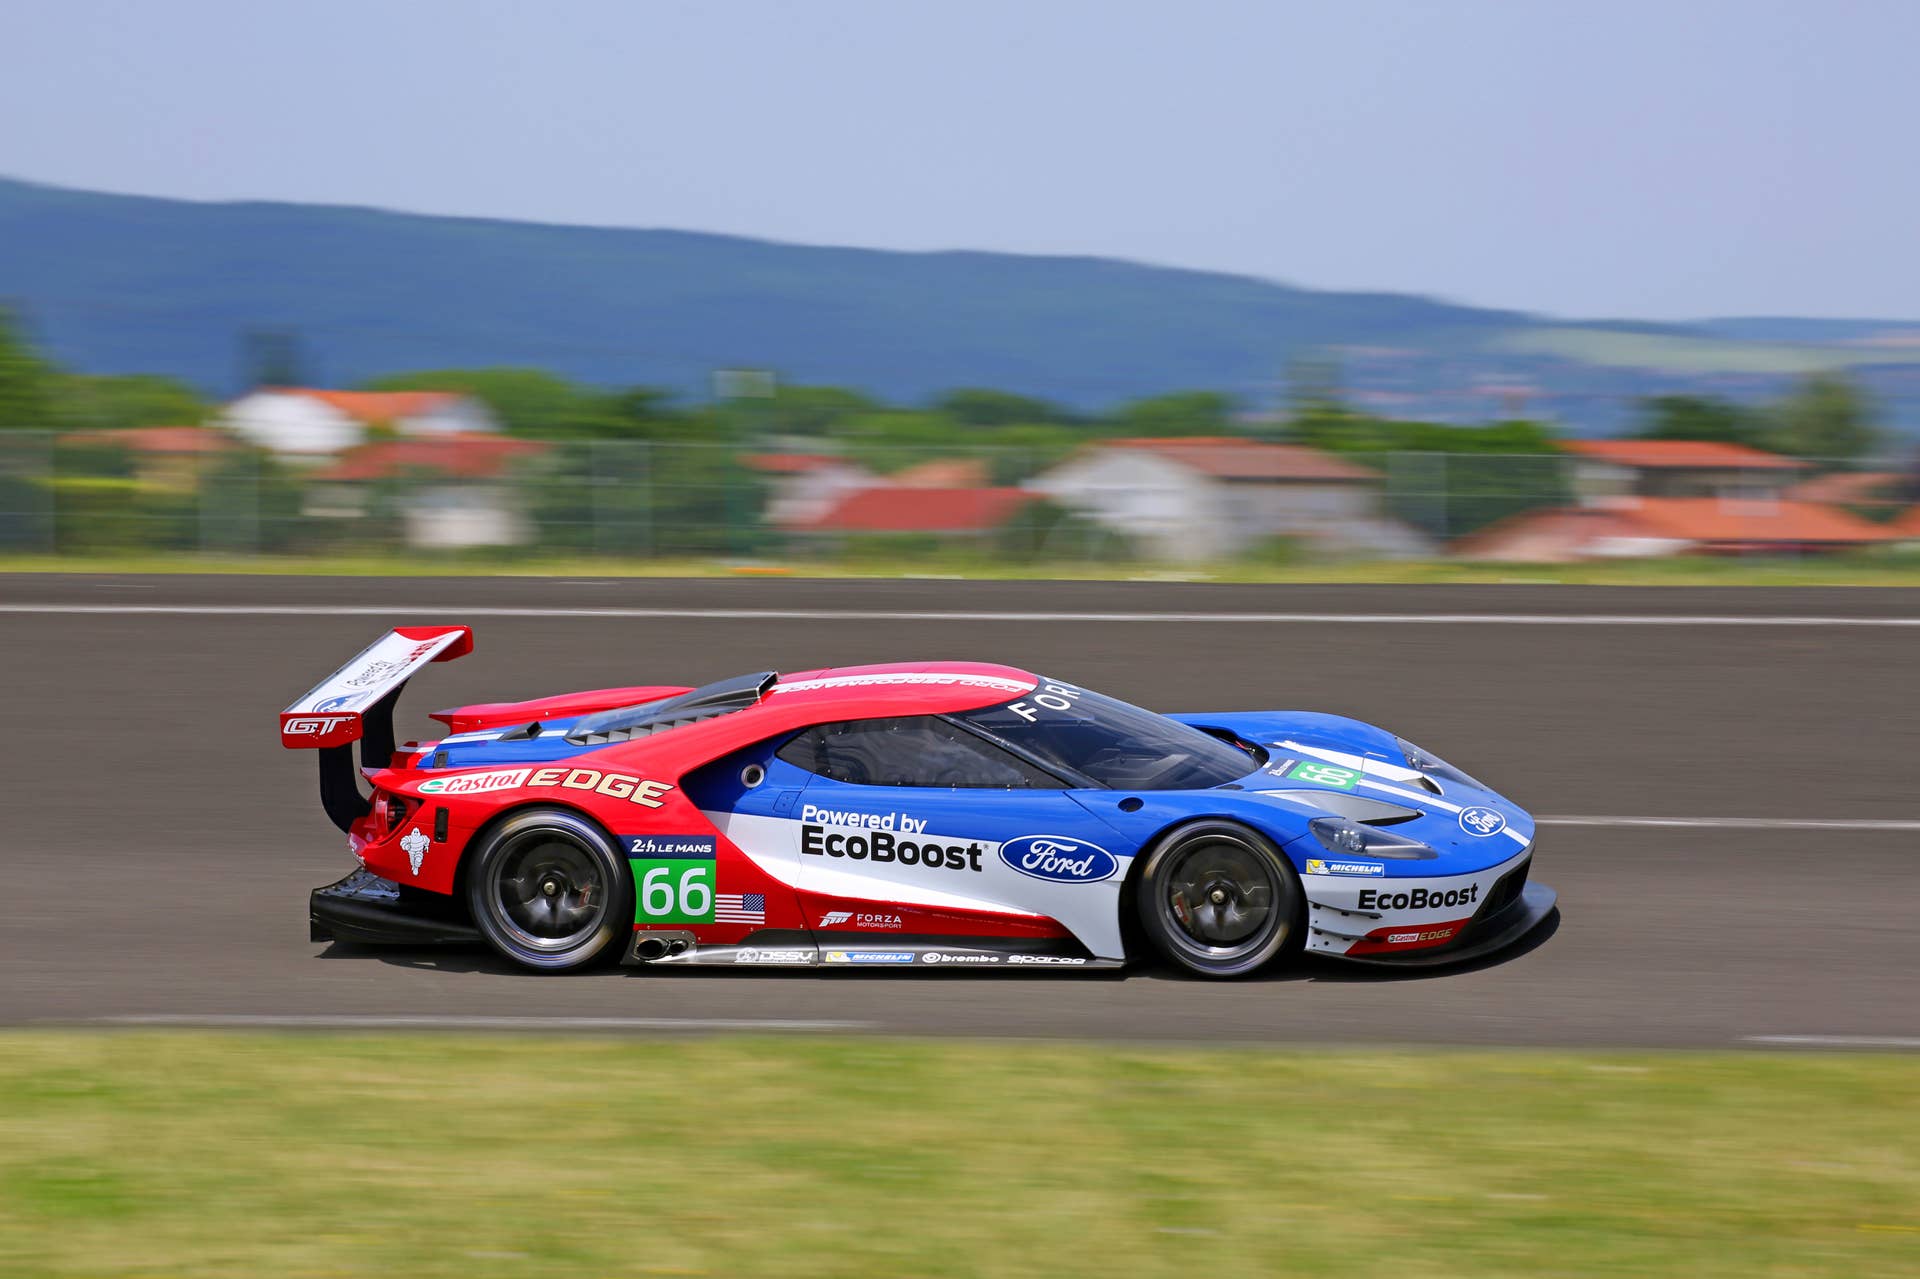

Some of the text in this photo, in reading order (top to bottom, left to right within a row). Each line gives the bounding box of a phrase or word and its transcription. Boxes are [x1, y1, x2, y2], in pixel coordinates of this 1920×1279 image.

[1007, 676, 1081, 722] FOR
[283, 716, 357, 736] GT
[445, 768, 674, 809] Castrol EDGE
[801, 804, 928, 834] Powered by
[658, 844, 673, 853] LE
[675, 844, 712, 853] MANS
[801, 825, 983, 872] EcoBoost
[1022, 839, 1093, 876] Ford
[1330, 863, 1382, 873] MICHELIN
[642, 867, 711, 916] 66
[1358, 882, 1479, 910] EcoBoost
[856, 913, 902, 924] FORZA
[1419, 928, 1453, 941] EDGE
[852, 953, 912, 961] MICHELIN
[941, 953, 1000, 963] brembo
